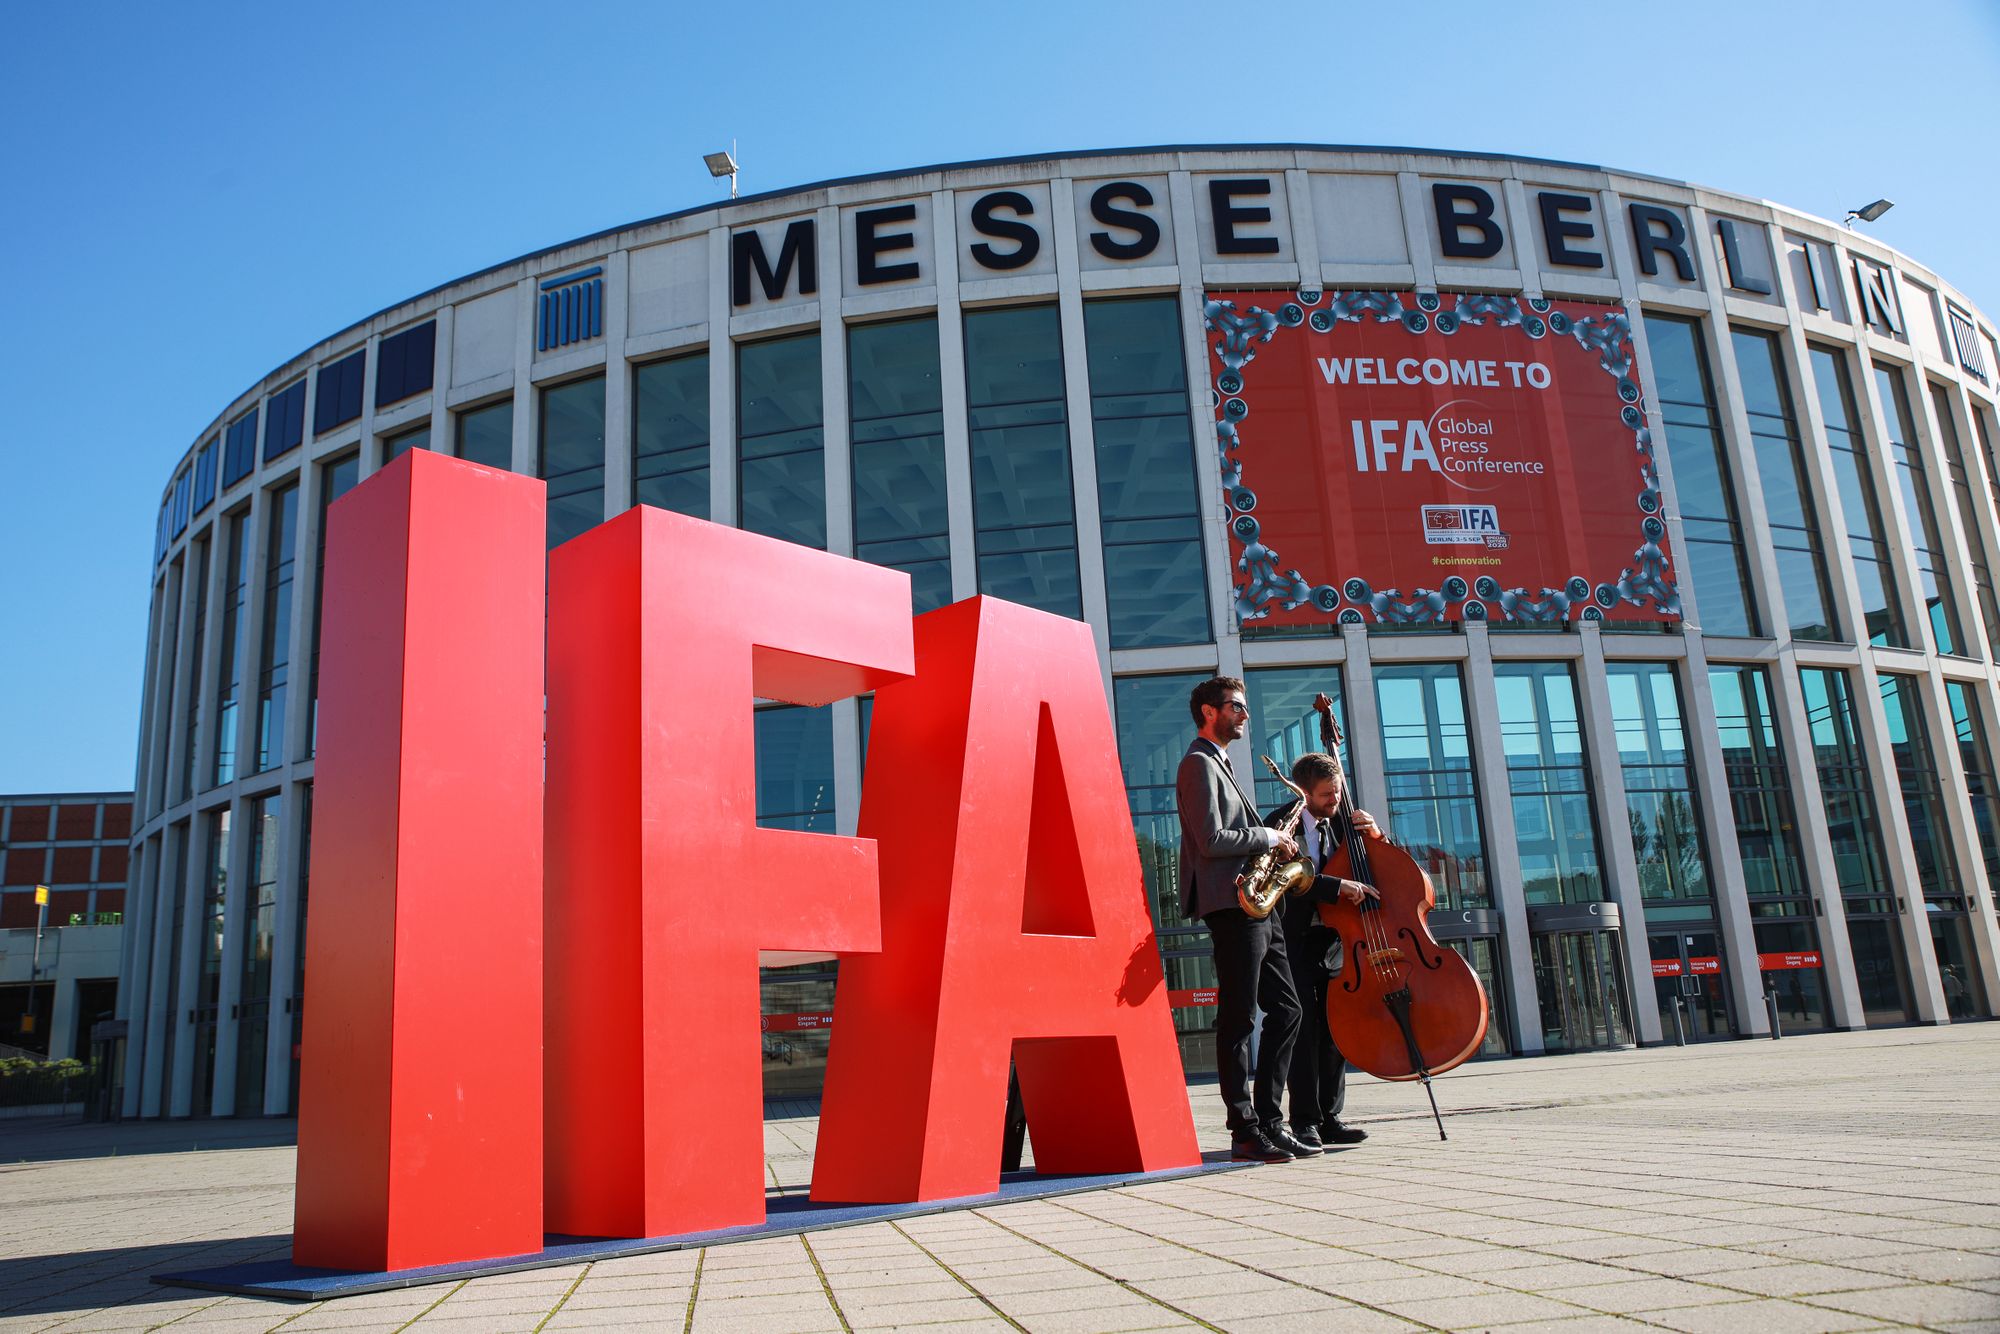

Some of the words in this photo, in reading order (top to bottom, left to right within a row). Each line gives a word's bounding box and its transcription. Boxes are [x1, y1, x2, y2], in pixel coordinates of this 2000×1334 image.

[732, 177, 1281, 306] MESSE
[1431, 183, 1903, 336] BERLIN
[1317, 357, 1500, 387] WELCOME
[1504, 361, 1552, 389] TO
[1437, 418, 1493, 435] Global
[1351, 419, 1442, 472] IFA
[1440, 437, 1489, 454] Press
[1443, 456, 1544, 474] Conference
[1461, 508, 1496, 530] IFA
[1432, 556, 1502, 566] #coinnovation
[296, 447, 1203, 1273] IFA
[1462, 911, 1472, 923] C
[1589, 903, 1598, 915] C
